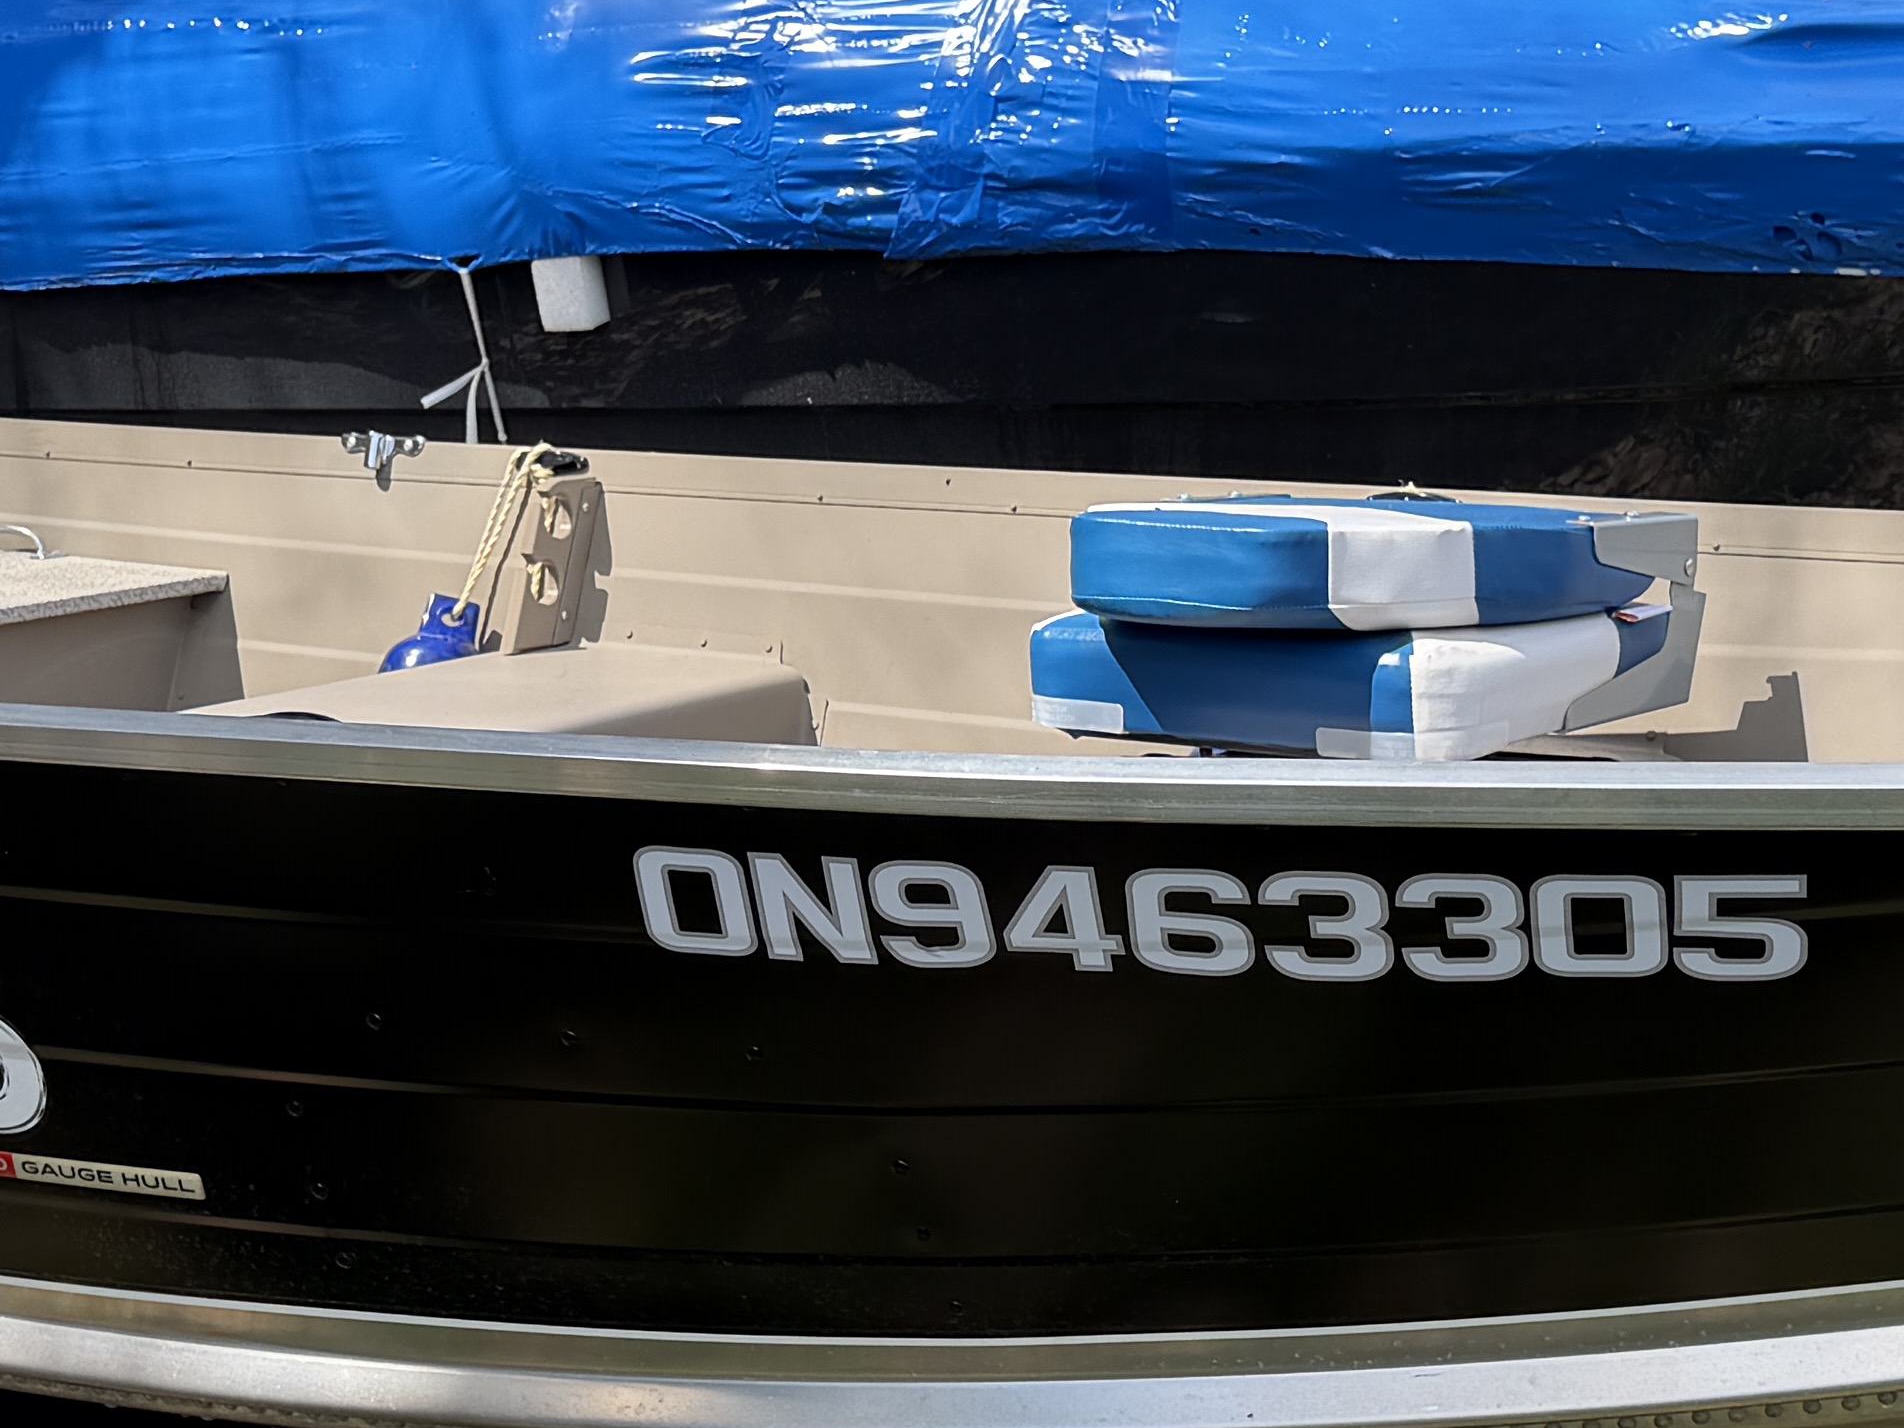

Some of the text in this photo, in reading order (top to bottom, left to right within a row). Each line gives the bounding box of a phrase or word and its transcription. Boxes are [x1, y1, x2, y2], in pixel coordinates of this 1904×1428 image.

[632, 844, 1809, 983] ON9463305
[22, 1160, 114, 1185] GAUGE
[121, 1172, 196, 1193] HULL
